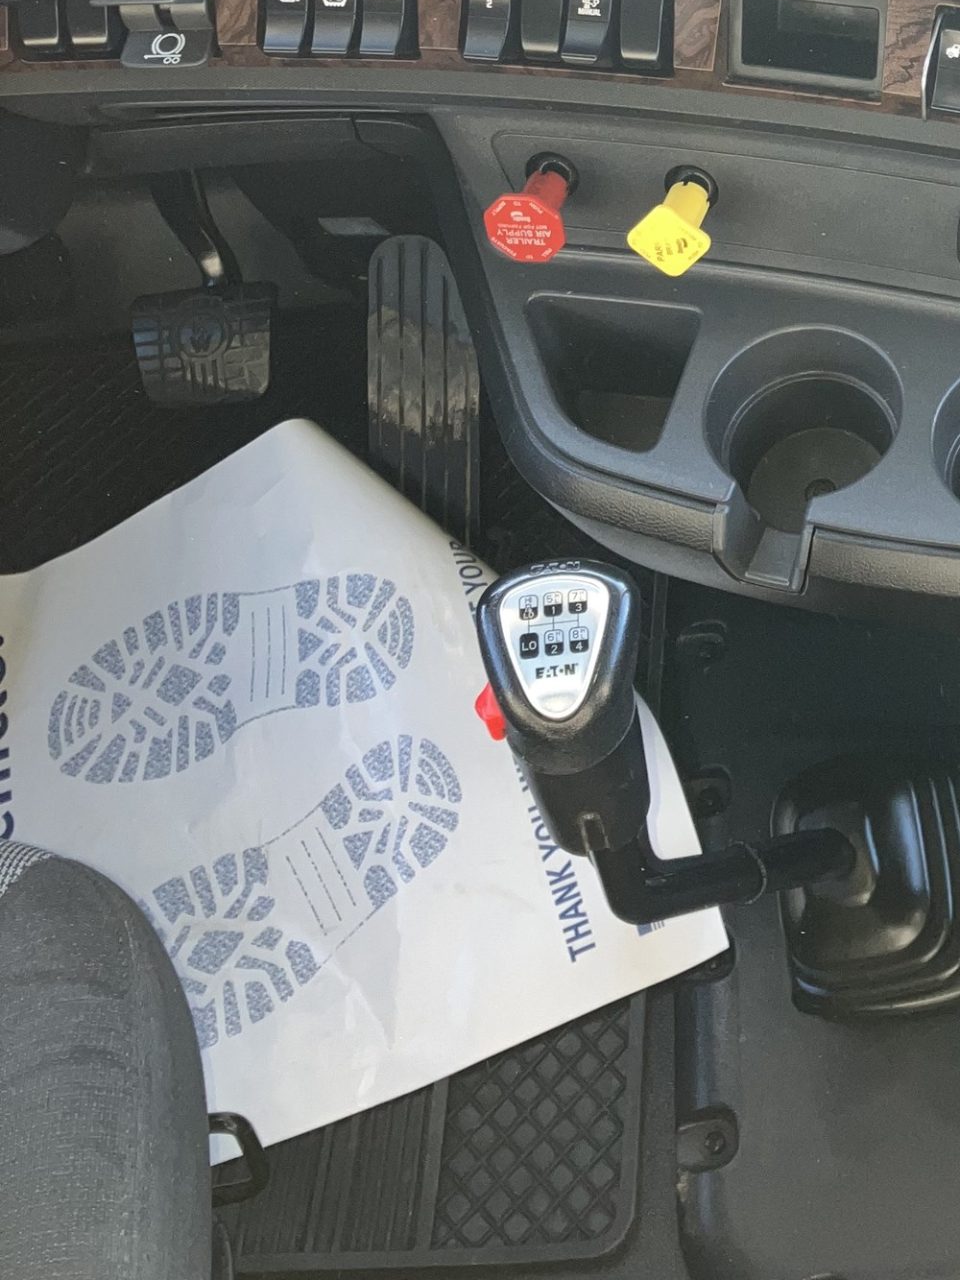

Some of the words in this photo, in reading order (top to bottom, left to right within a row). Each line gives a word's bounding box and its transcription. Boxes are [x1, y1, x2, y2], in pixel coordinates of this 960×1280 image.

[485, 0, 493, 8] 2
[496, 228, 533, 238] SUPPLY
[505, 237, 546, 246] TRAILER
[575, 603, 583, 612] 3
[547, 633, 554, 642] 6
[572, 630, 579, 639] 8
[521, 641, 537, 651] LO
[551, 645, 558, 655] 2
[575, 641, 584, 651] 4
[546, 859, 596, 963] THANK
